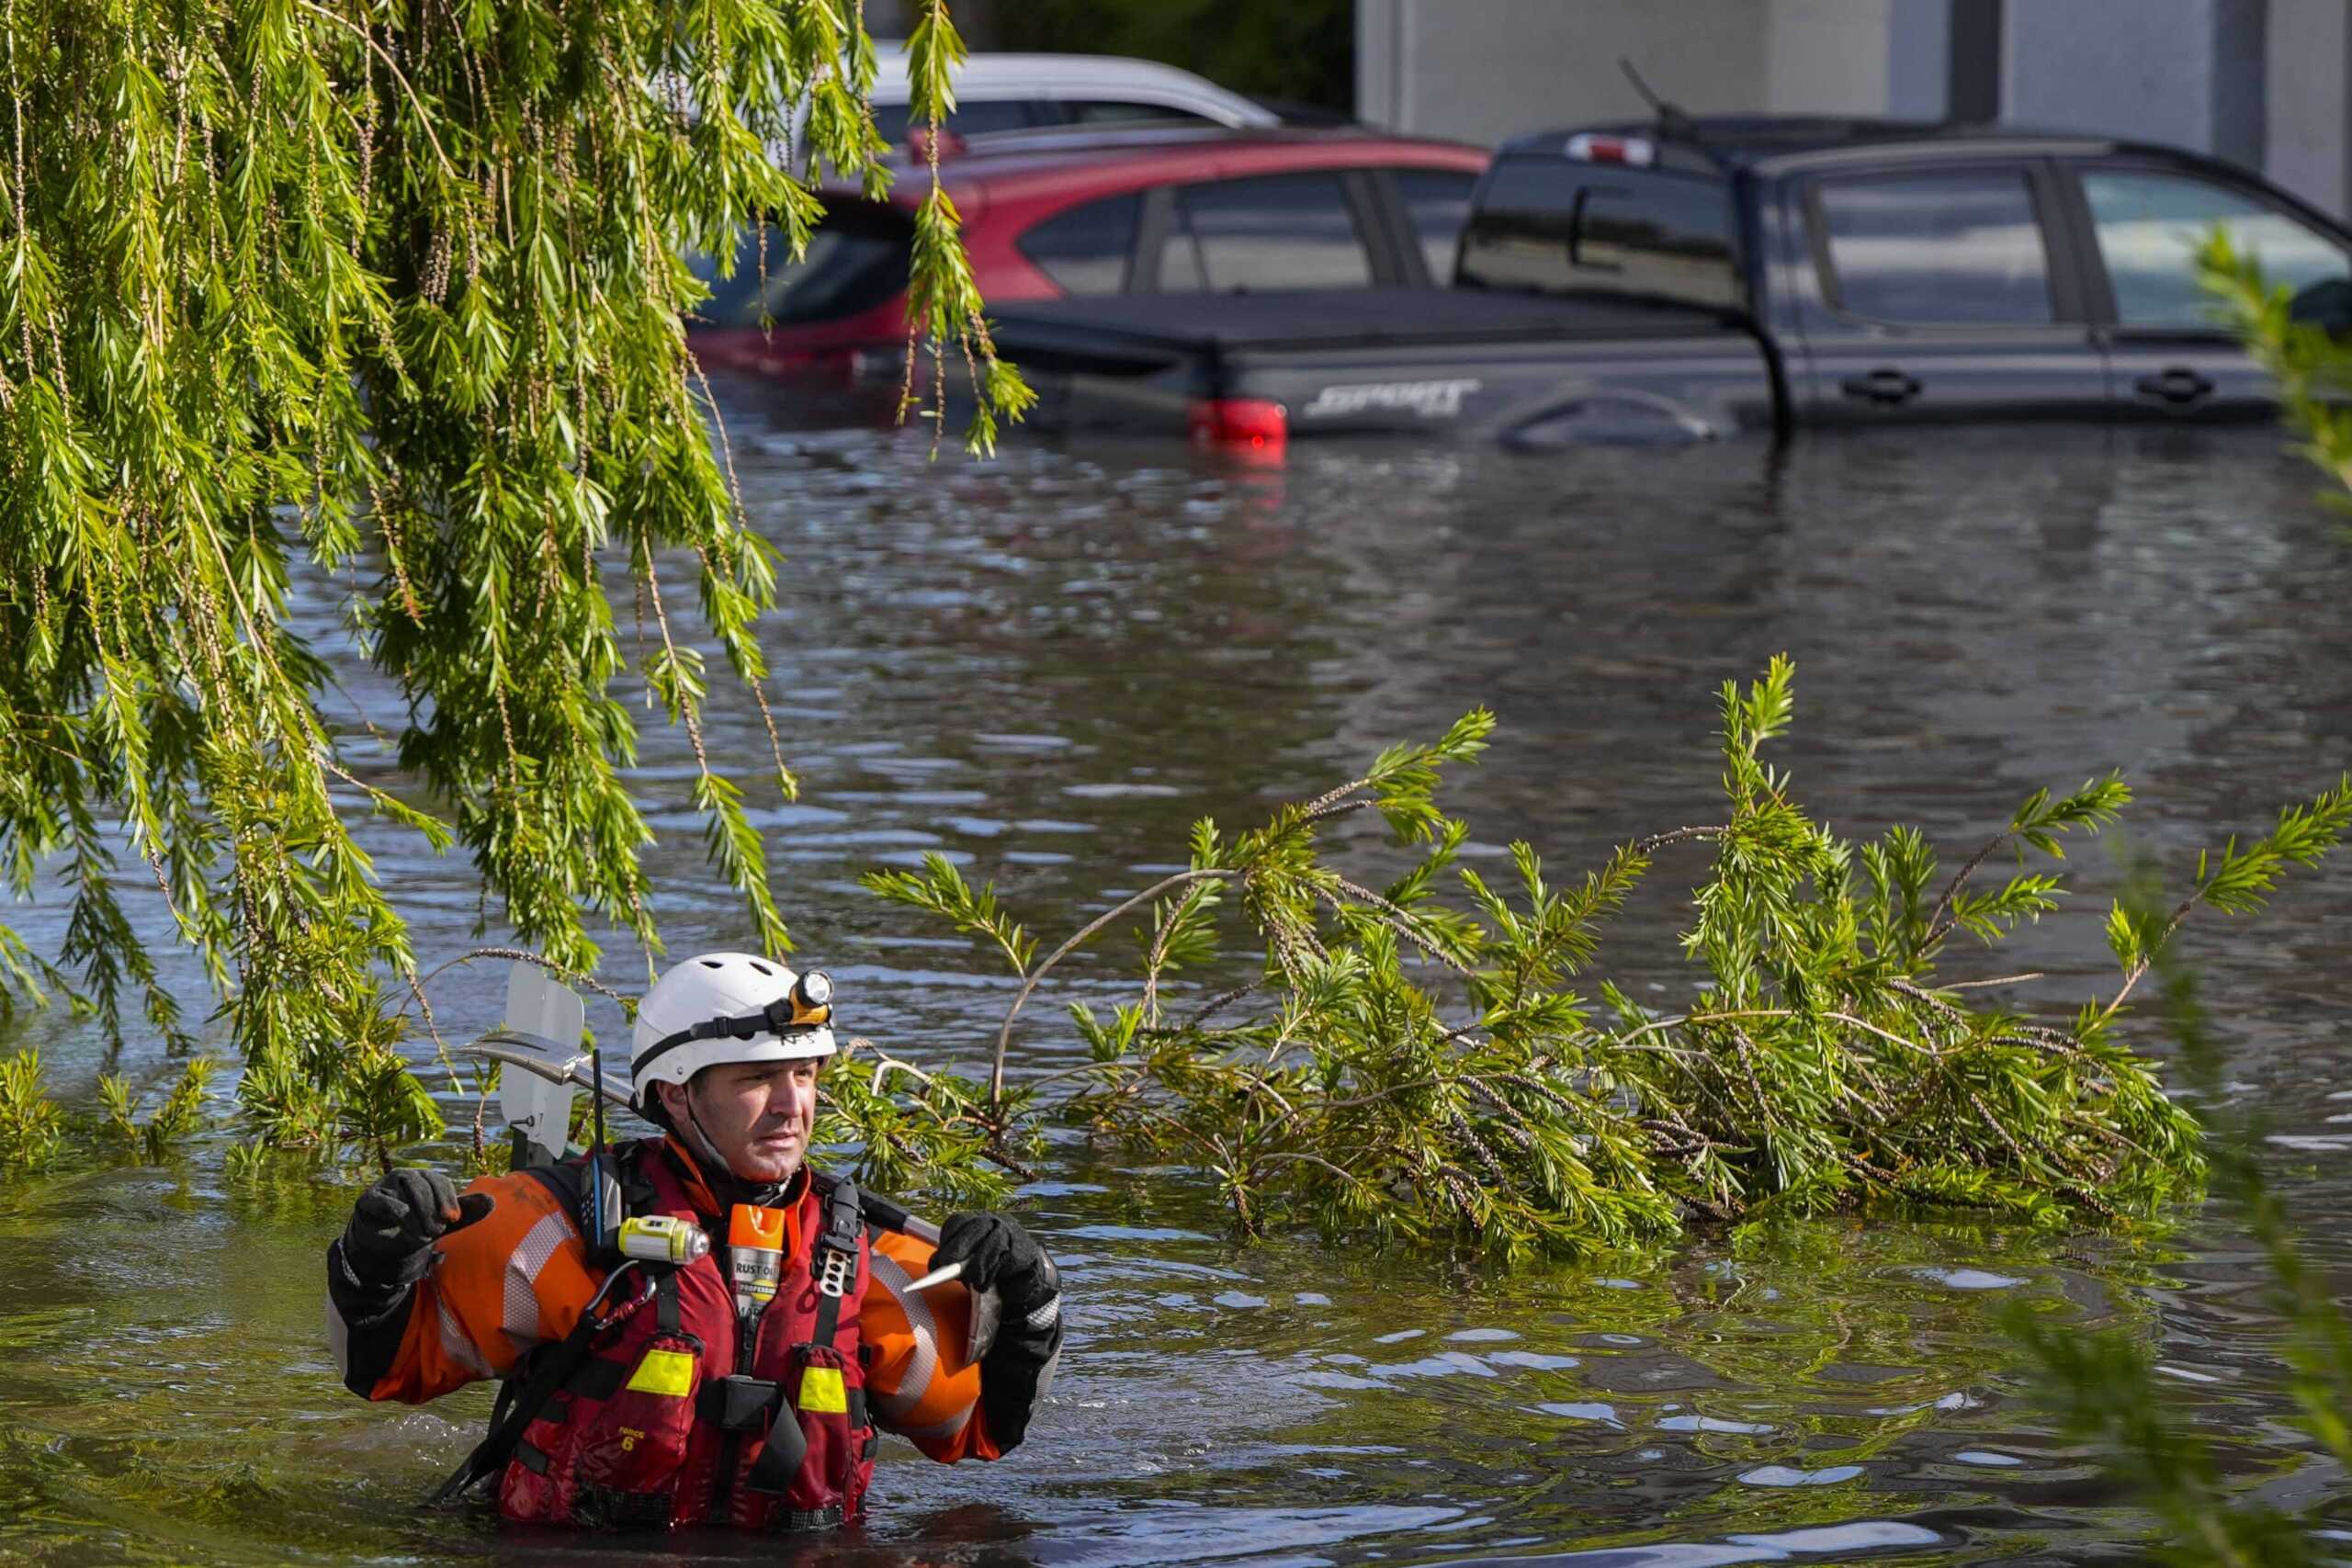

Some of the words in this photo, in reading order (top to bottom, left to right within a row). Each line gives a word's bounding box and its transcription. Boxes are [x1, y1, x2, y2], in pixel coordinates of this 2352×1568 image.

[1303, 378, 1484, 418] SPORT
[736, 1263, 762, 1275] RUST
[621, 1436, 634, 1451] 6
